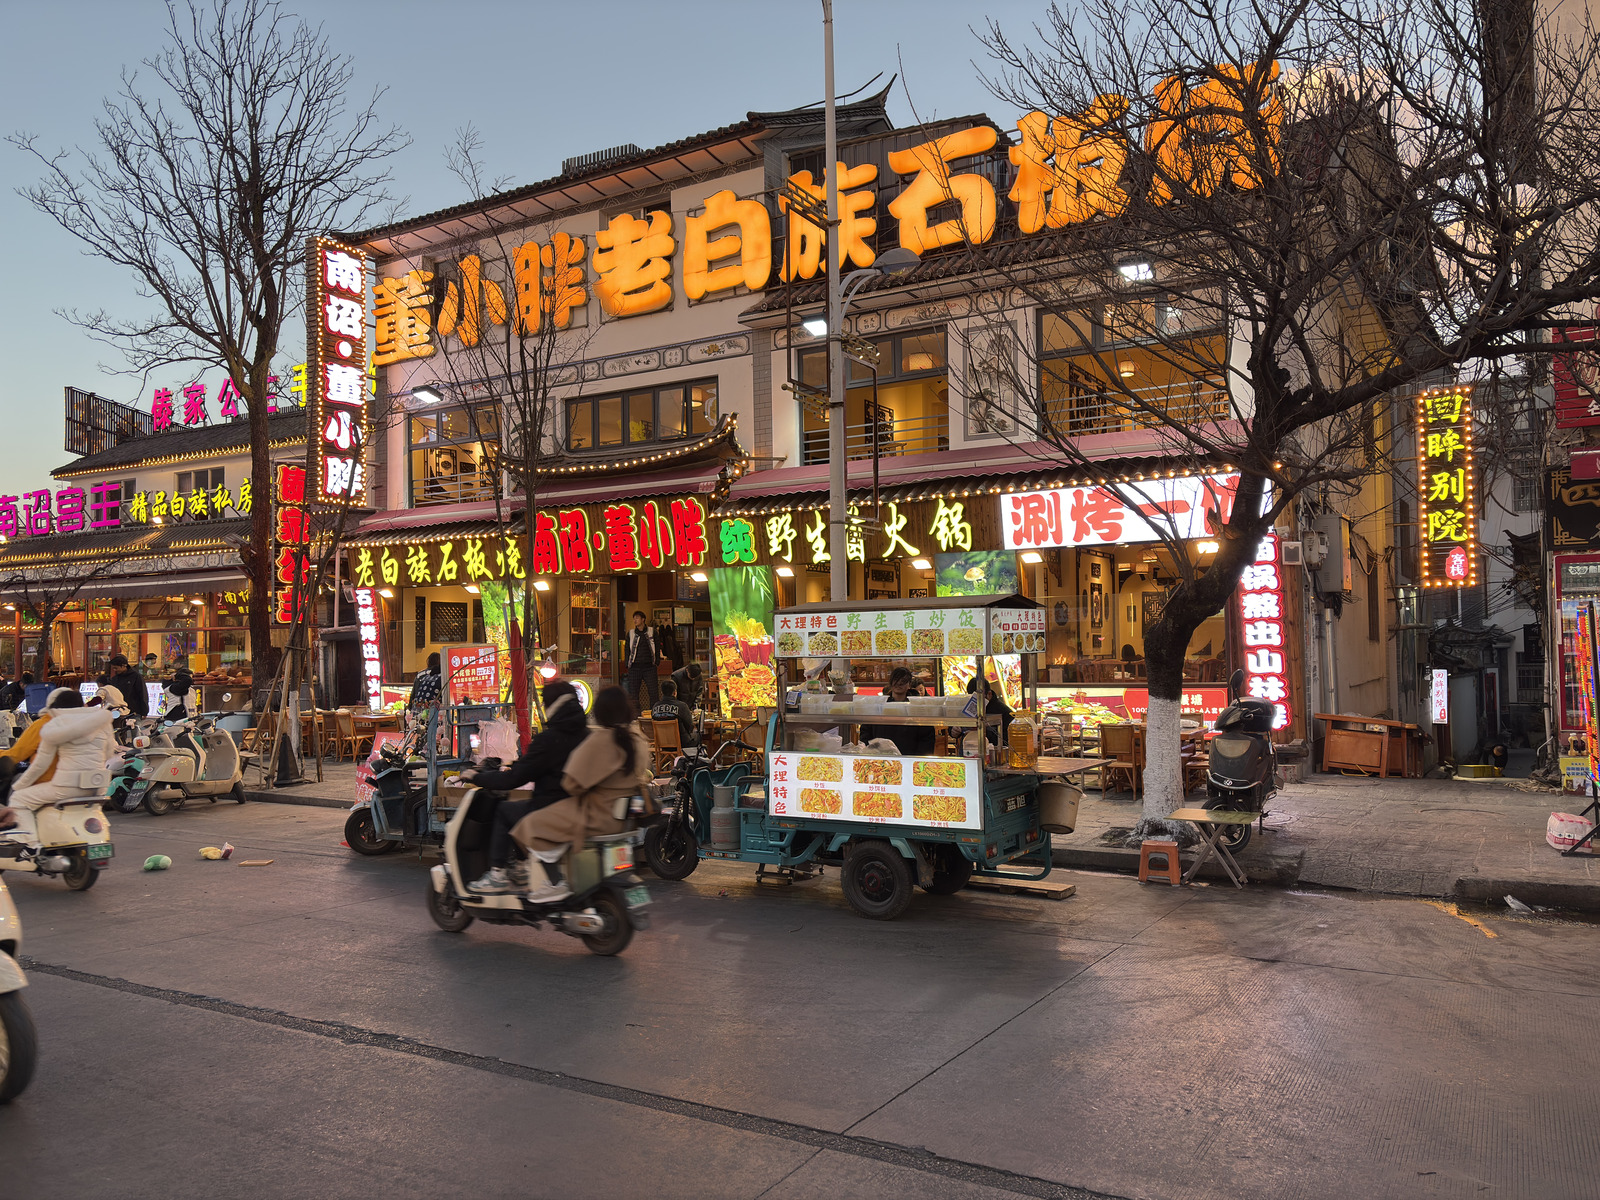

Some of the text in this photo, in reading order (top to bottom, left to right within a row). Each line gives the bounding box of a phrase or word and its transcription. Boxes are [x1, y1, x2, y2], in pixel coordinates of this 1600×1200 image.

[1425, 394, 1468, 542] 回眸别院
[129, 478, 272, 523] 精品白族私房
[355, 535, 527, 588] 老白族石板烧
[533, 497, 707, 574] 南诏·董小胖
[1450, 553, 1465, 576] 客栈
[780, 609, 977, 630] 大理特色 野生菌炒饭
[773, 755, 788, 815] 大理特色
